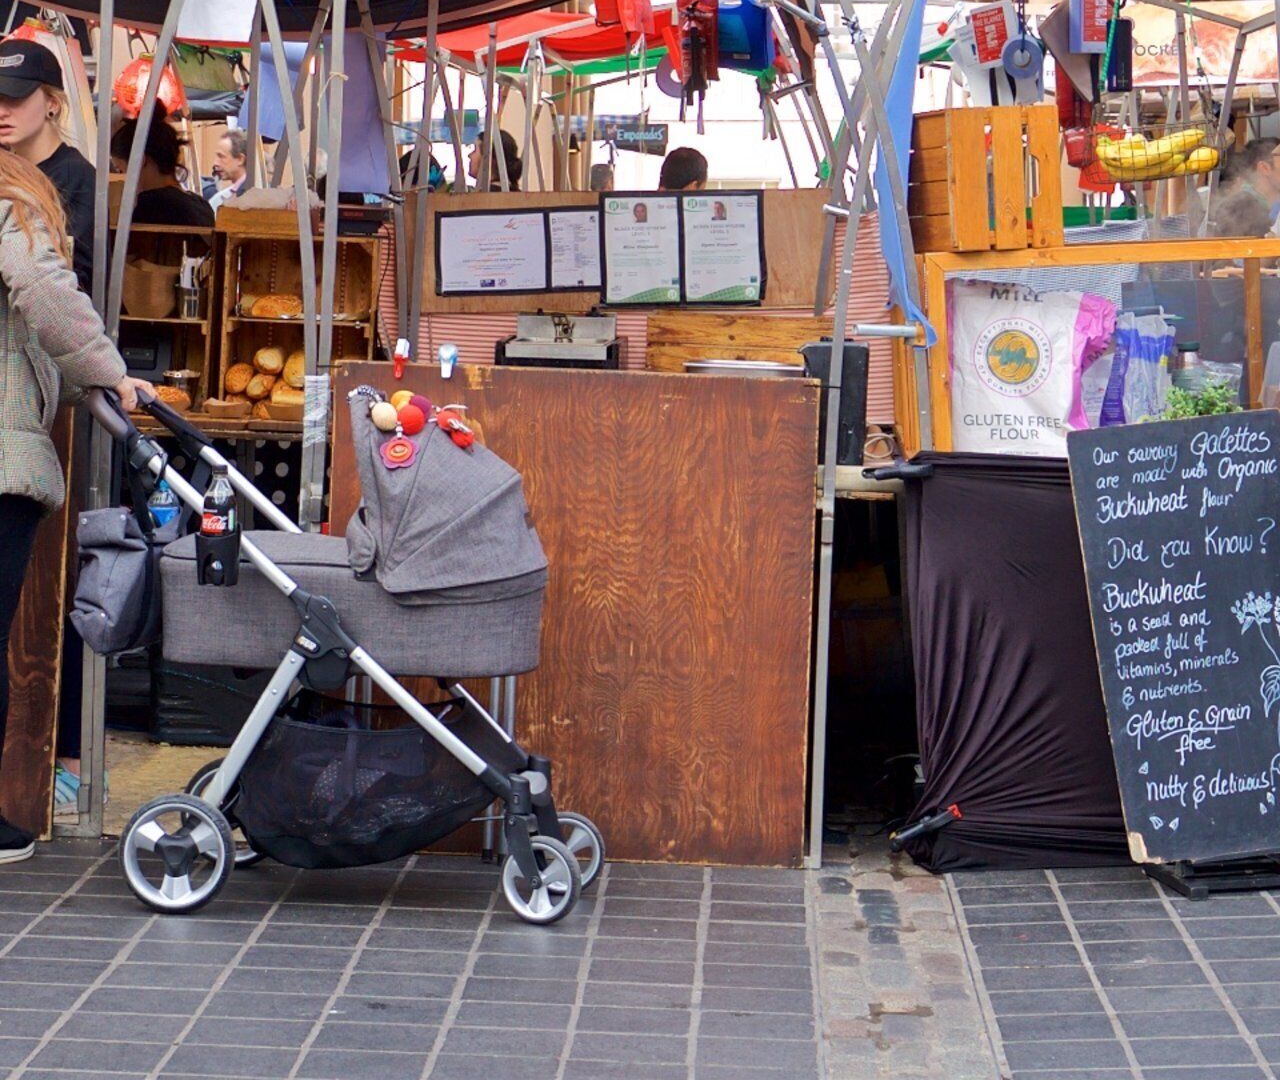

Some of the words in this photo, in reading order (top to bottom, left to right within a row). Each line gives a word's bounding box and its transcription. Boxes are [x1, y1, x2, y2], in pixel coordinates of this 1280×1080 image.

[964, 414, 1024, 427] GLUTEN
[1027, 416, 1062, 428] FREE
[990, 428, 1040, 440] FLOUR
[1093, 447, 1119, 466] Our
[1190, 426, 1271, 465] Galettes
[1096, 475, 1120, 490] are
[1182, 461, 1208, 480] with
[1218, 457, 1278, 492] Organic
[1096, 485, 1188, 524] Buckwheat
[1200, 487, 1234, 517] flour
[1108, 537, 1149, 569] Did
[1160, 538, 1191, 568] you
[1102, 571, 1207, 613] Buckwheat
[1110, 617, 1122, 637] is
[1127, 618, 1138, 632] a
[1142, 612, 1172, 632] seed
[1179, 608, 1212, 628] and
[1115, 638, 1160, 667] packed
[1164, 631, 1190, 658] full
[1194, 628, 1208, 653] of
[1117, 660, 1178, 680] vitamins,
[1180, 648, 1240, 670] minerals
[1122, 687, 1136, 710] &
[1139, 677, 1208, 702] nutrients.
[1126, 709, 1184, 750] Gluten
[1205, 703, 1252, 735] Grain
[1175, 736, 1216, 766] free
[1192, 774, 1206, 809] &
